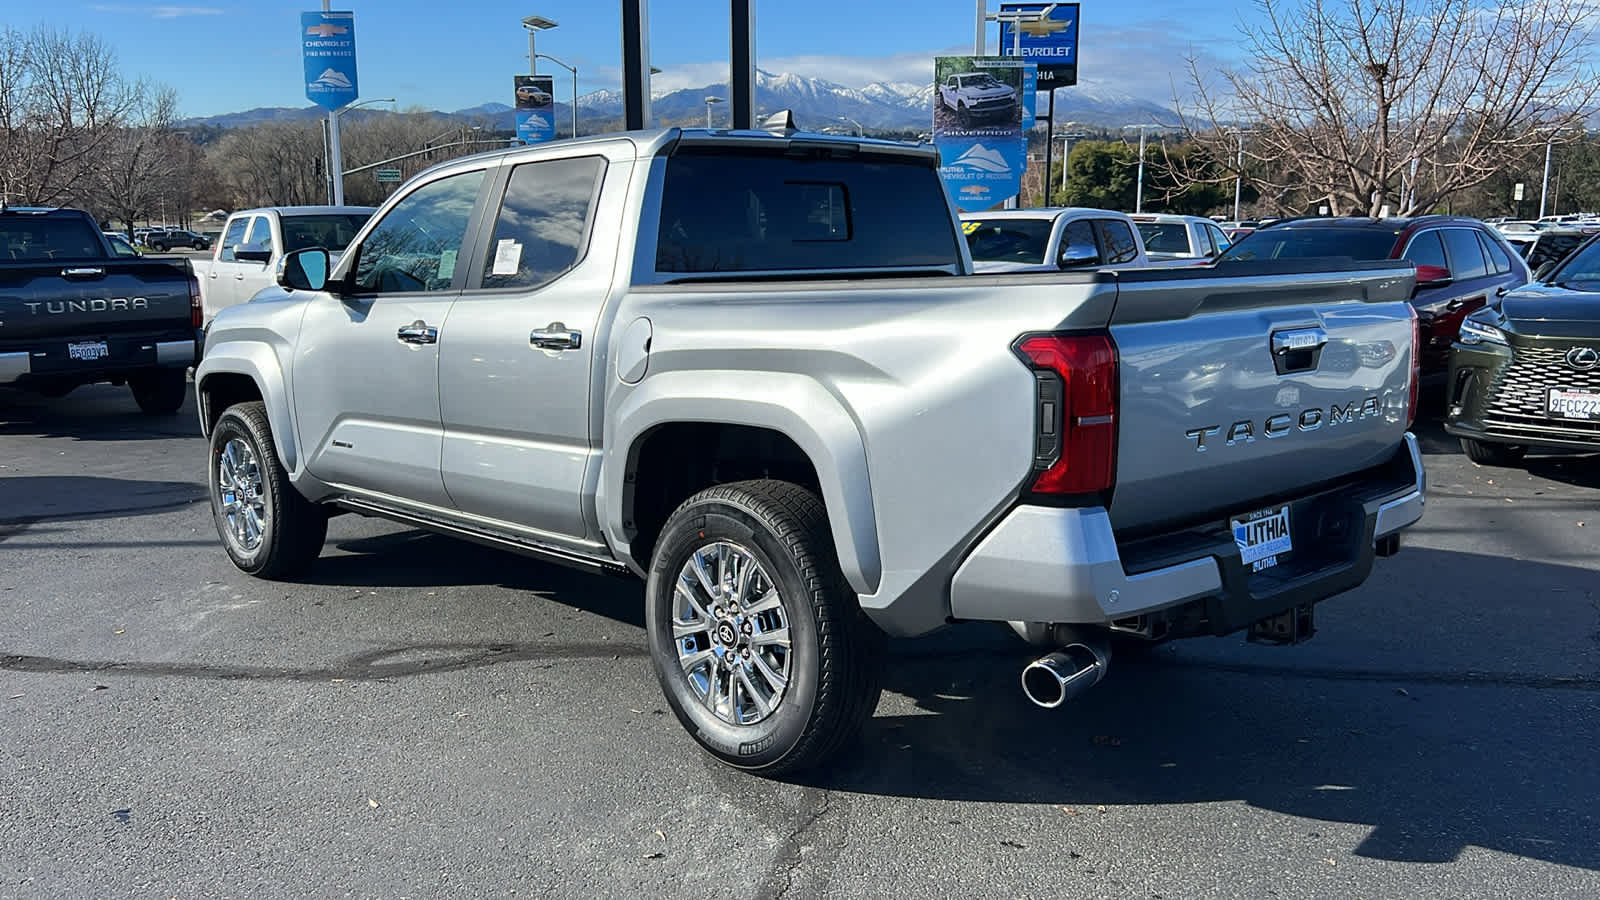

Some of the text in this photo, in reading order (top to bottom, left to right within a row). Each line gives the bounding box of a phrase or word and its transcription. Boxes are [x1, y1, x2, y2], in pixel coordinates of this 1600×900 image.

[1006, 46, 1072, 57] CEVROLET
[1036, 71, 1055, 80] HIA
[24, 297, 148, 315] TUNDRA
[1552, 399, 1600, 414] 9FCC22
[1185, 396, 1381, 452] TACOMA
[1247, 516, 1289, 547] LITHIA
